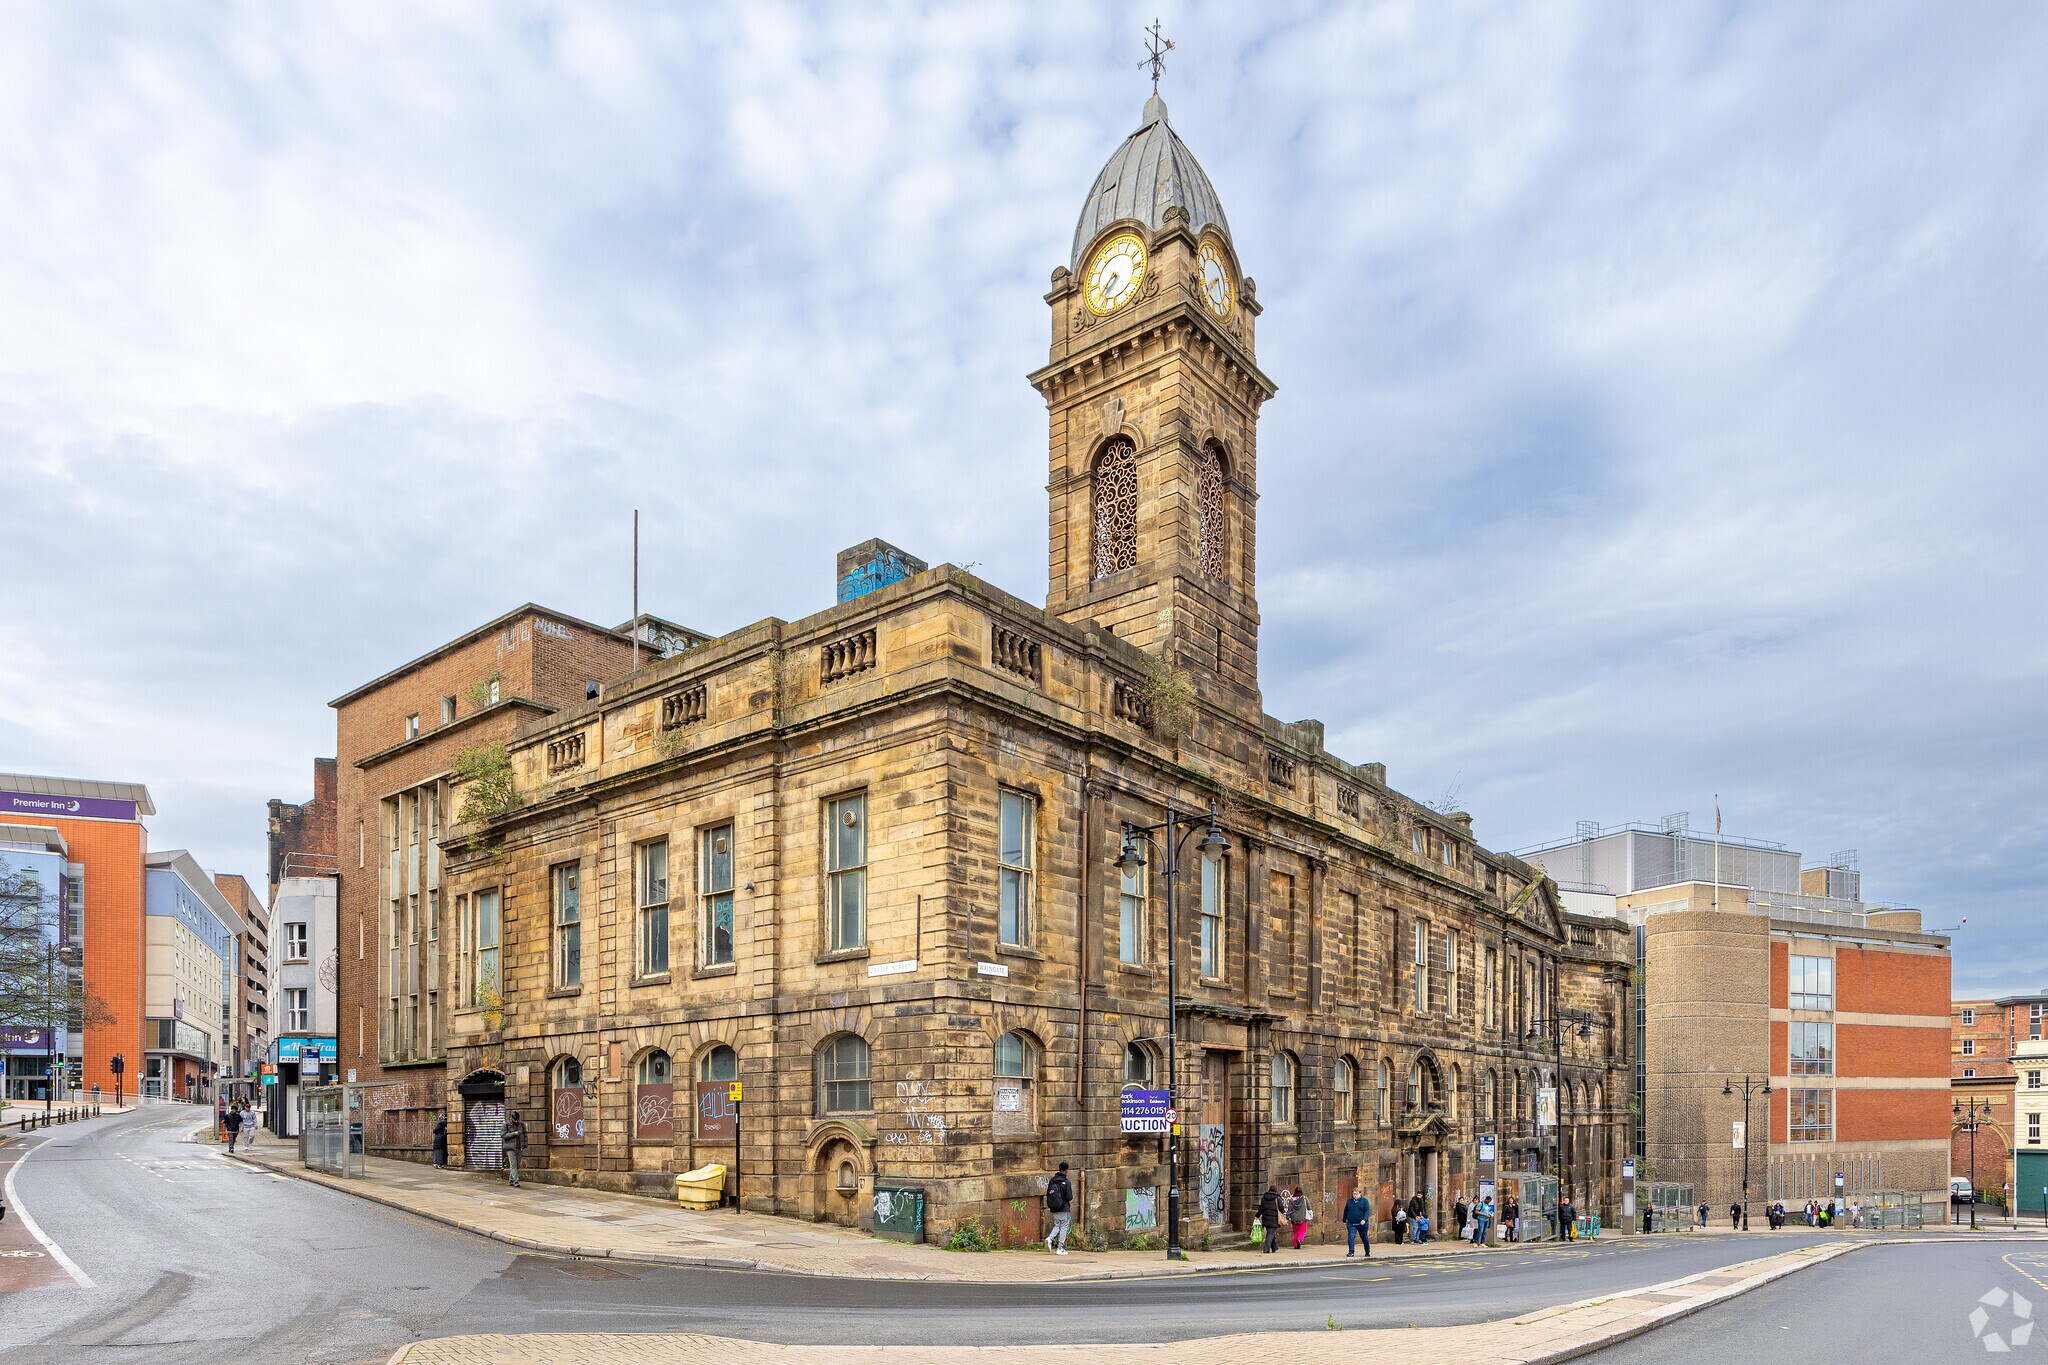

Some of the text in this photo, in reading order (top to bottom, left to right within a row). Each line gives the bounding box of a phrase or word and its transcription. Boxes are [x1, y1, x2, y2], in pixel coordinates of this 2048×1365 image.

[13, 798, 65, 809] Premier Inn
[870, 963, 911, 974] CASTLE STREET
[979, 965, 1005, 974] WAINGATE
